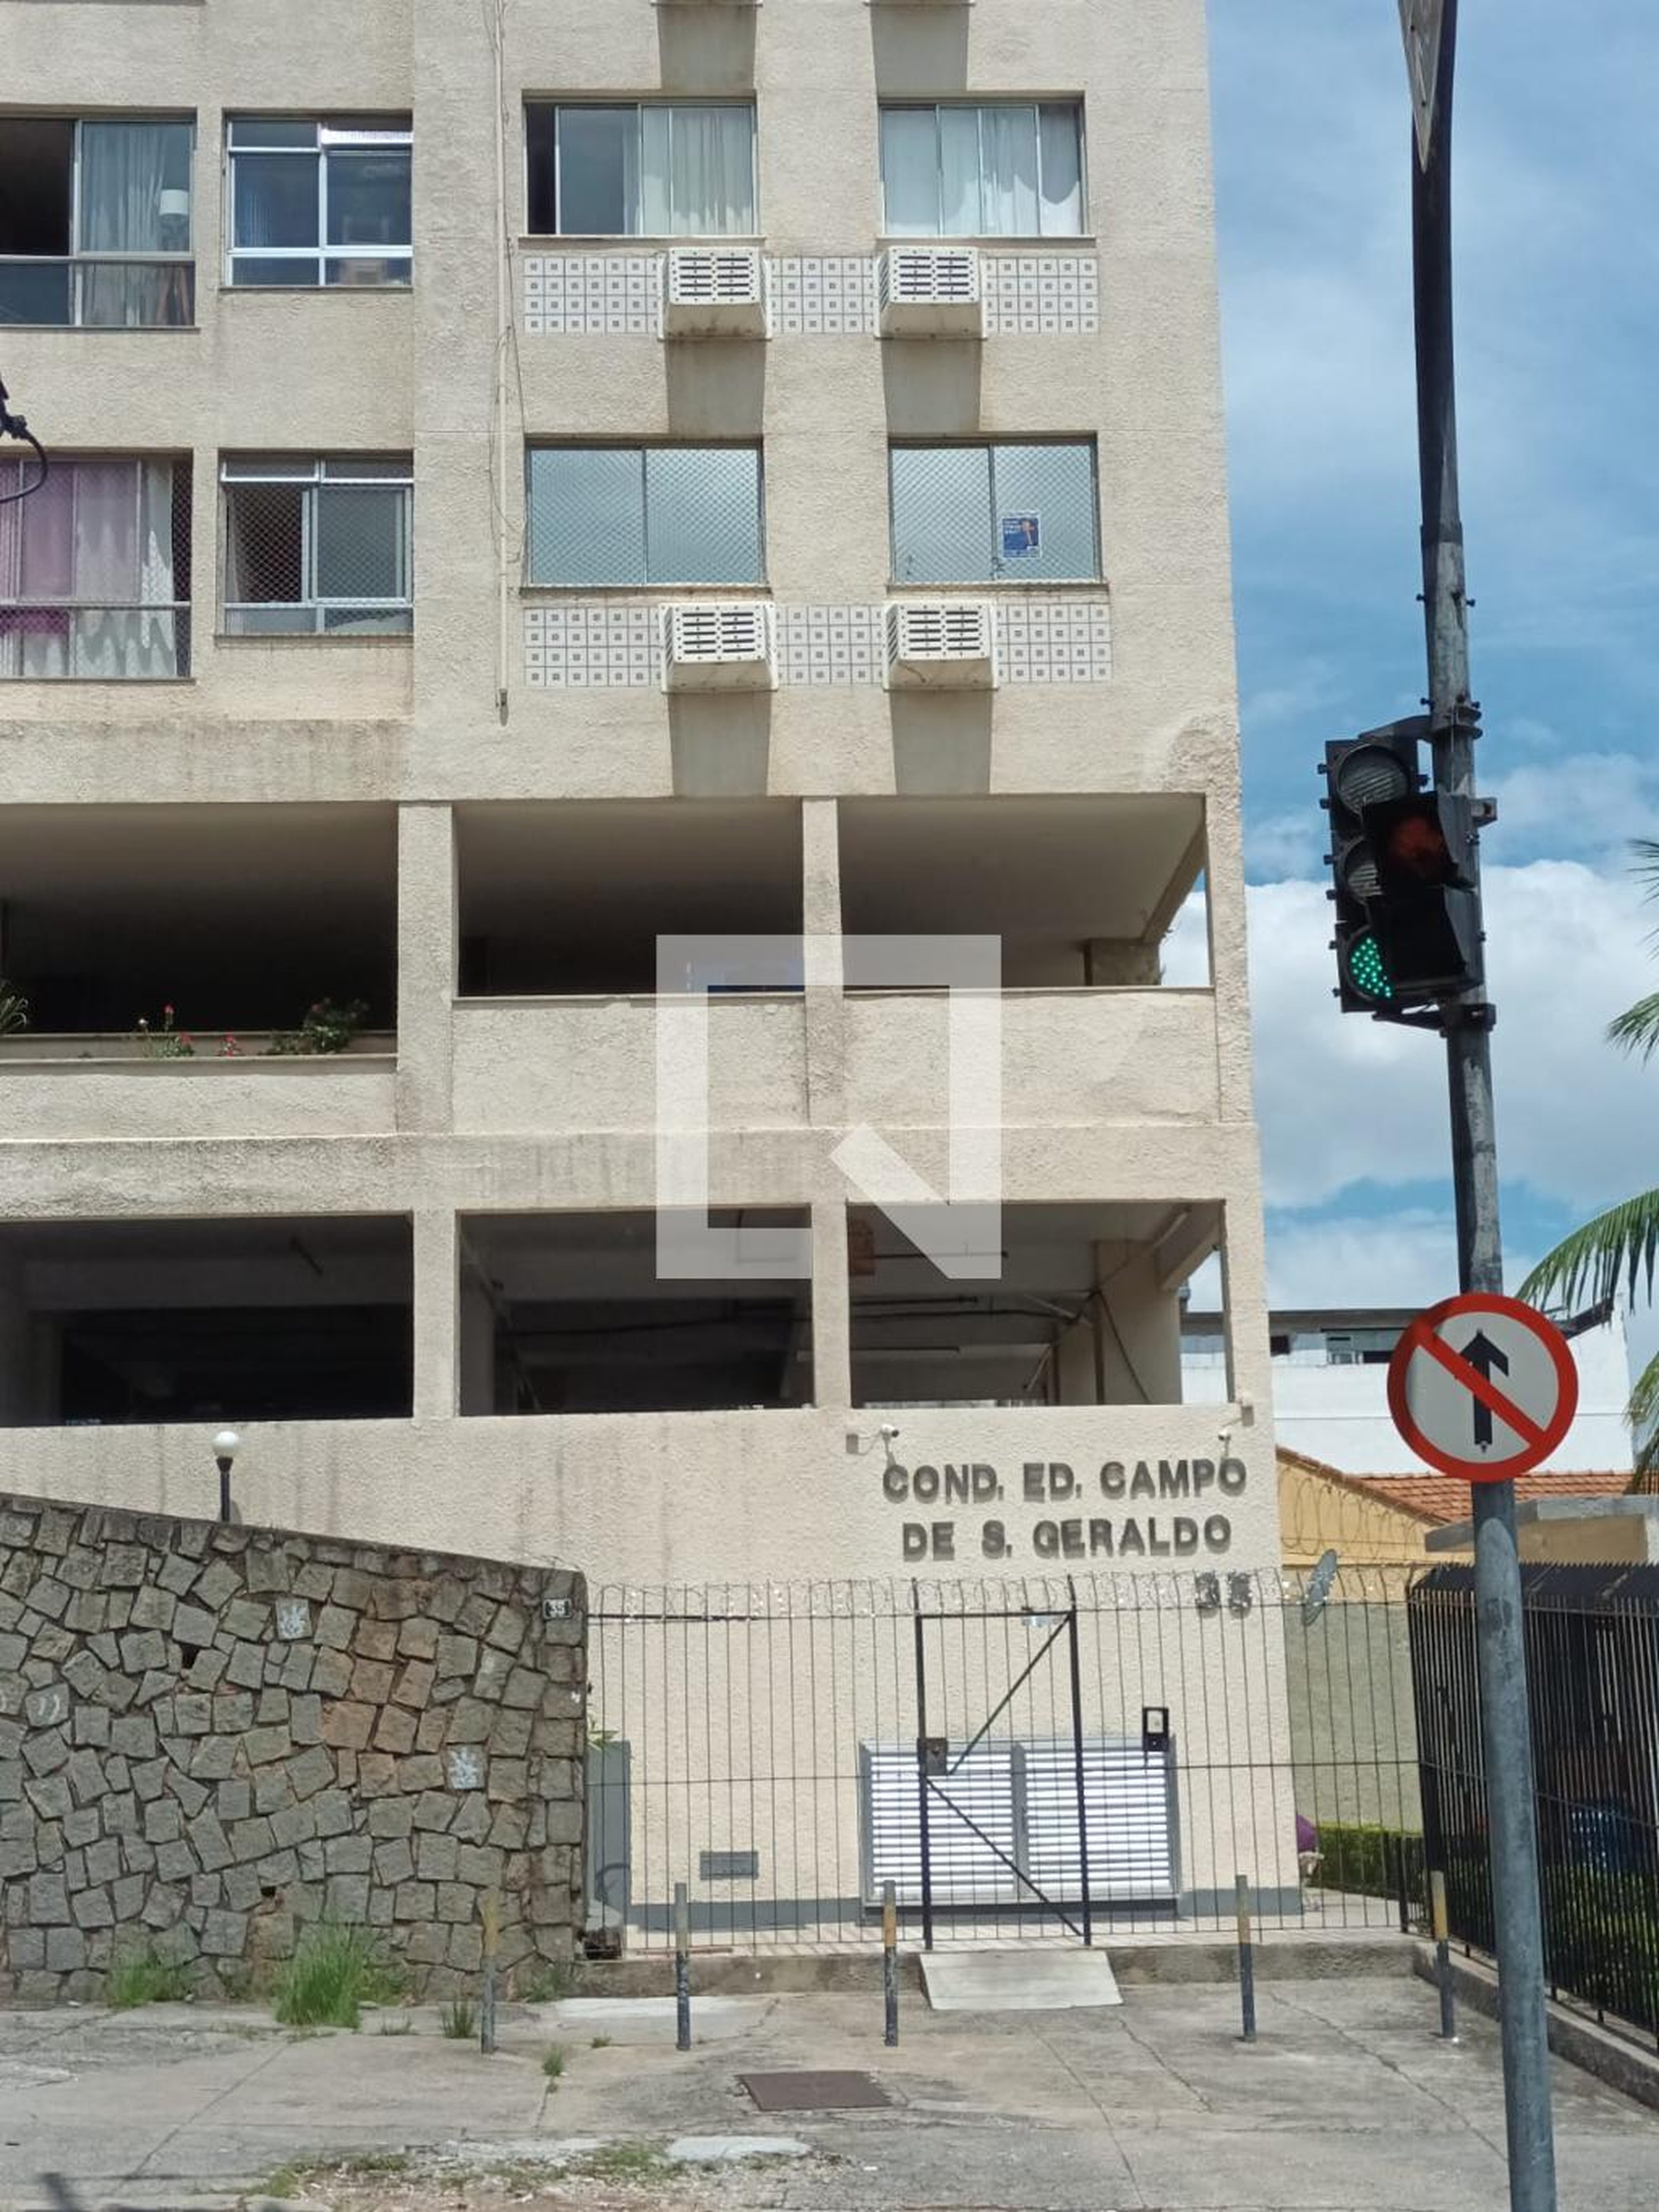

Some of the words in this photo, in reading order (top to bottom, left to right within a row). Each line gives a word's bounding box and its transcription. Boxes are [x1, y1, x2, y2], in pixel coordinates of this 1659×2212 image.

[883, 1464, 1004, 1504] COND.
[1023, 1463, 1082, 1503] ED.
[1100, 1458, 1246, 1498] CAMPO
[903, 1522, 955, 1562] DE
[982, 1520, 1012, 1559] S.
[1033, 1514, 1231, 1559] GERALDO
